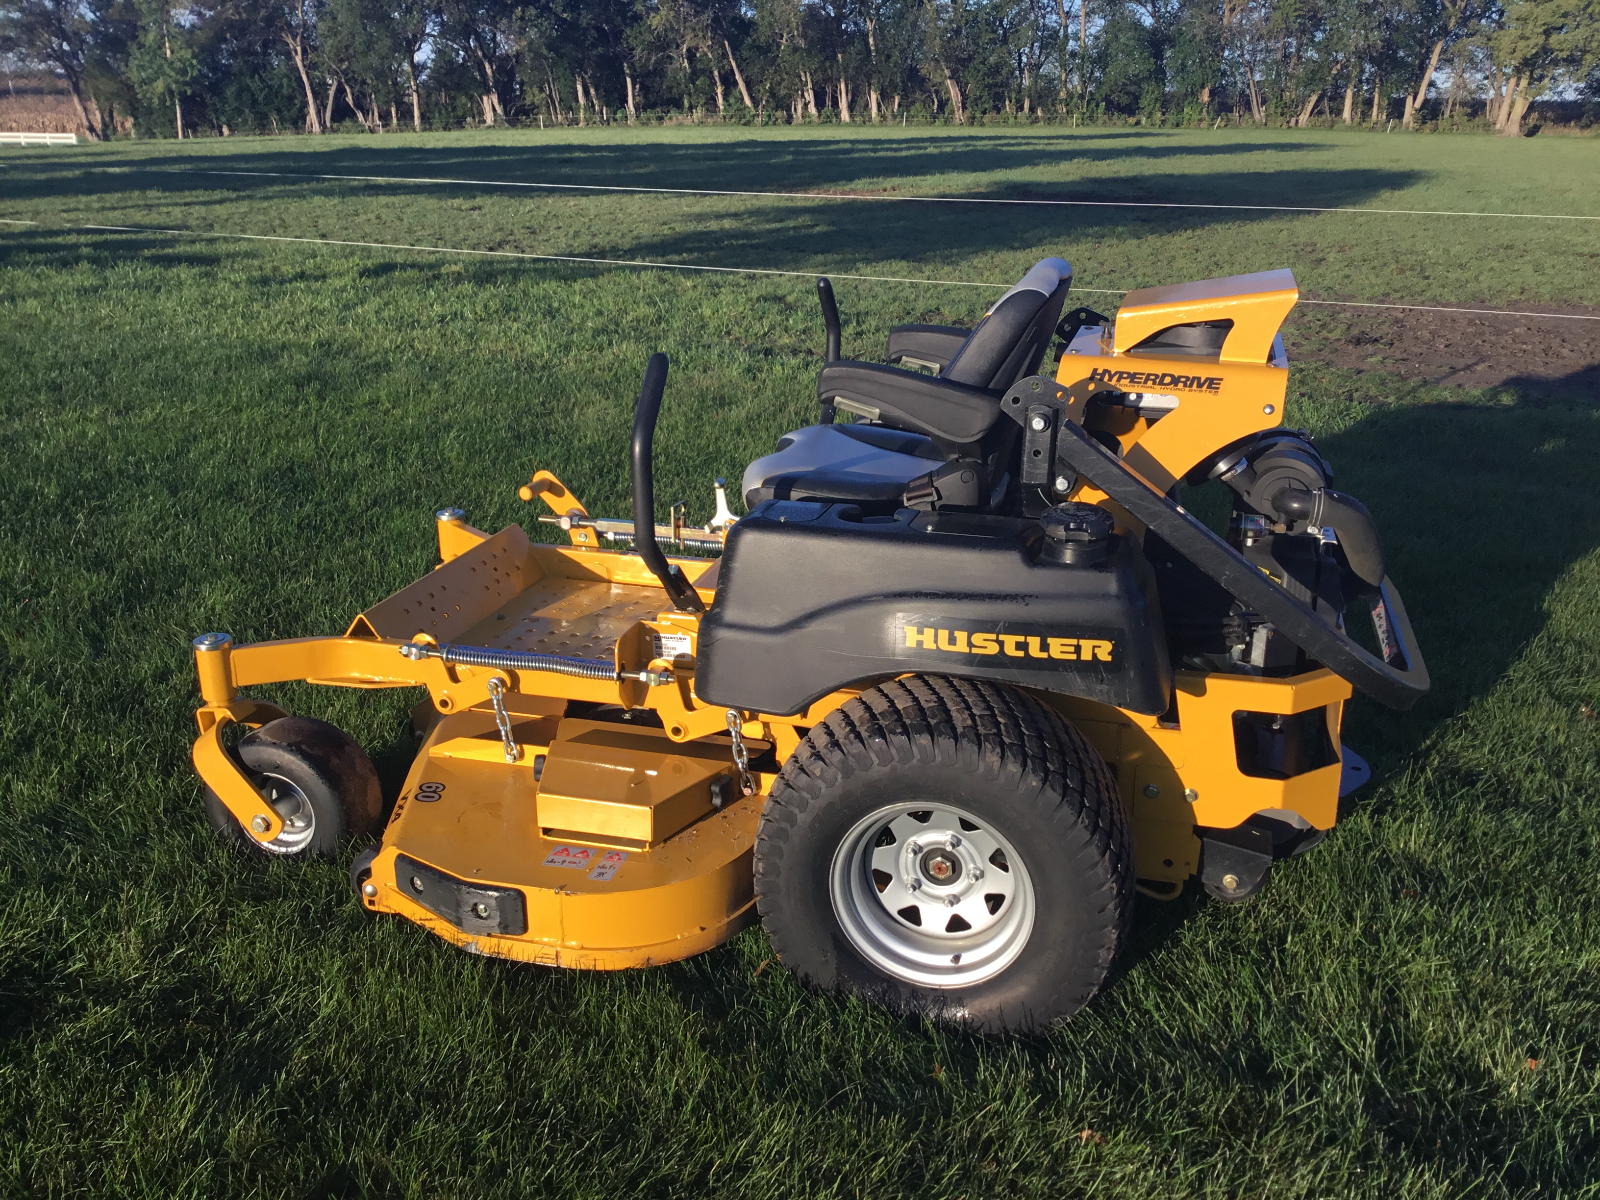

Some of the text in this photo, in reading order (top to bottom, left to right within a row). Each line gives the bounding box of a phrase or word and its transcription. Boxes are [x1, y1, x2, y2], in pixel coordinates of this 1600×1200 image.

[1089, 368, 1224, 390] HYPERDRIVE
[904, 626, 1113, 662] HUSTLER
[414, 782, 446, 802] 60
